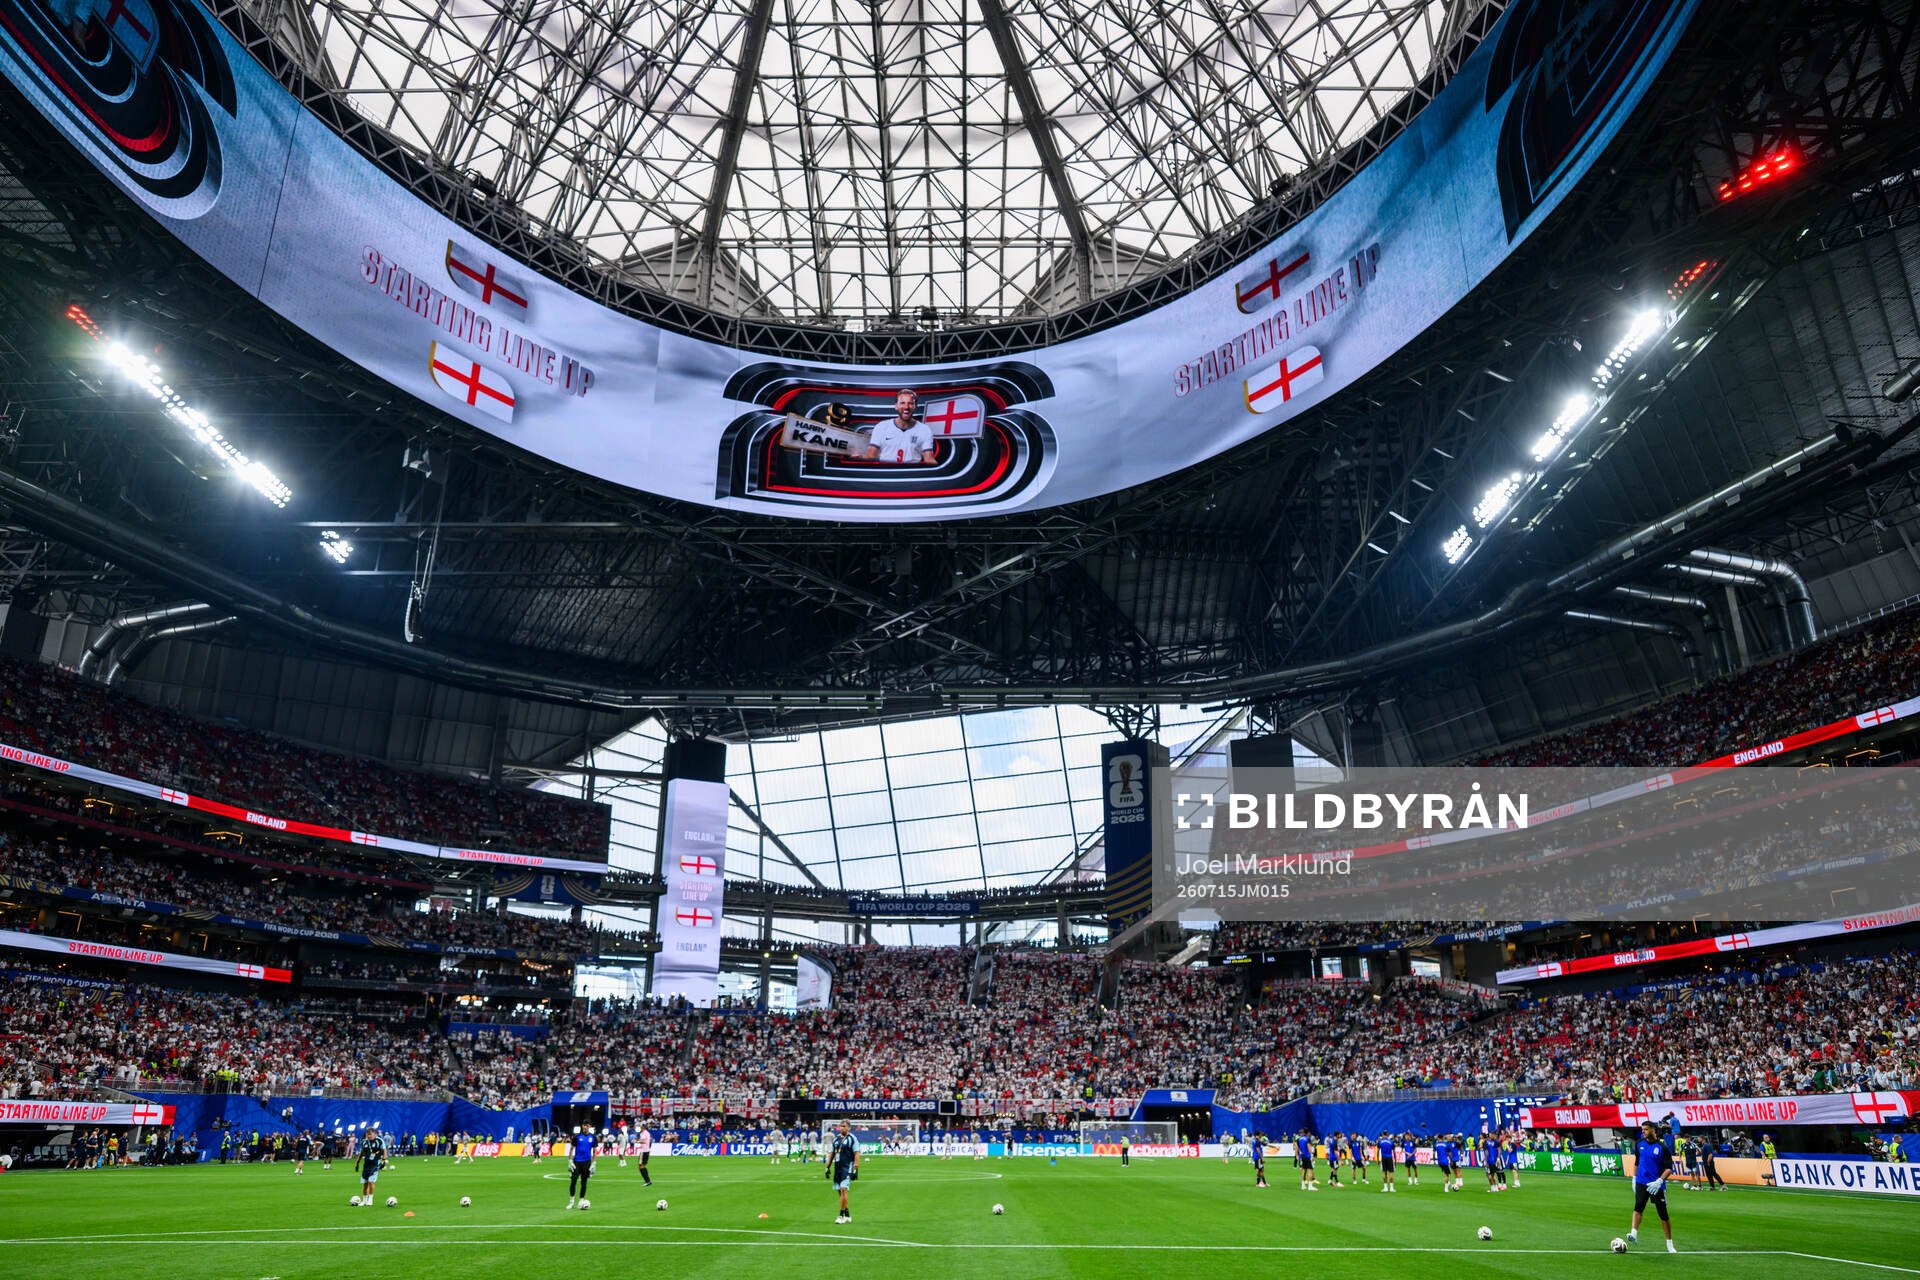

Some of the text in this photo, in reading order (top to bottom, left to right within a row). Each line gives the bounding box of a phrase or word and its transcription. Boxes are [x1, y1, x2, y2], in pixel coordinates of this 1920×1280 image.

[360, 245, 596, 398] STARTING LINE UP
[1174, 242, 1381, 398] STARTING LINE UP
[795, 420, 826, 433] HARRY
[792, 429, 848, 449] KANE
[0, 745, 69, 771] ING LINE UP
[1734, 741, 1784, 765] ENGLAND
[246, 811, 287, 830] ENGLAND
[1110, 813, 1145, 824] 2026
[460, 850, 506, 863] STARTING
[855, 903, 970, 911] FIFA WORLD CUP 2026
[1626, 894, 1676, 910] ATLANTA
[1843, 911, 1905, 930] STARTING
[264, 922, 277, 932] FIFA
[299, 928, 314, 937] CUP
[314, 930, 339, 939] 2026
[1454, 933, 1469, 941] FIFA
[69, 942, 163, 963] STARTING LINE UP
[447, 946, 496, 955] ATLANTA
[0, 1103, 107, 1120] STARTING LINE UP
[824, 1101, 936, 1110] FIFA WORLD CUP 2026
[1685, 1101, 1798, 1122] STARTING LINE UP
[1554, 1108, 1591, 1125] ENGLAND
[730, 1144, 774, 1155] ULTRA
[1004, 1142, 1077, 1157] Hisense
[1781, 1163, 1837, 1187] BANK
[1840, 1164, 1866, 1188] OF
